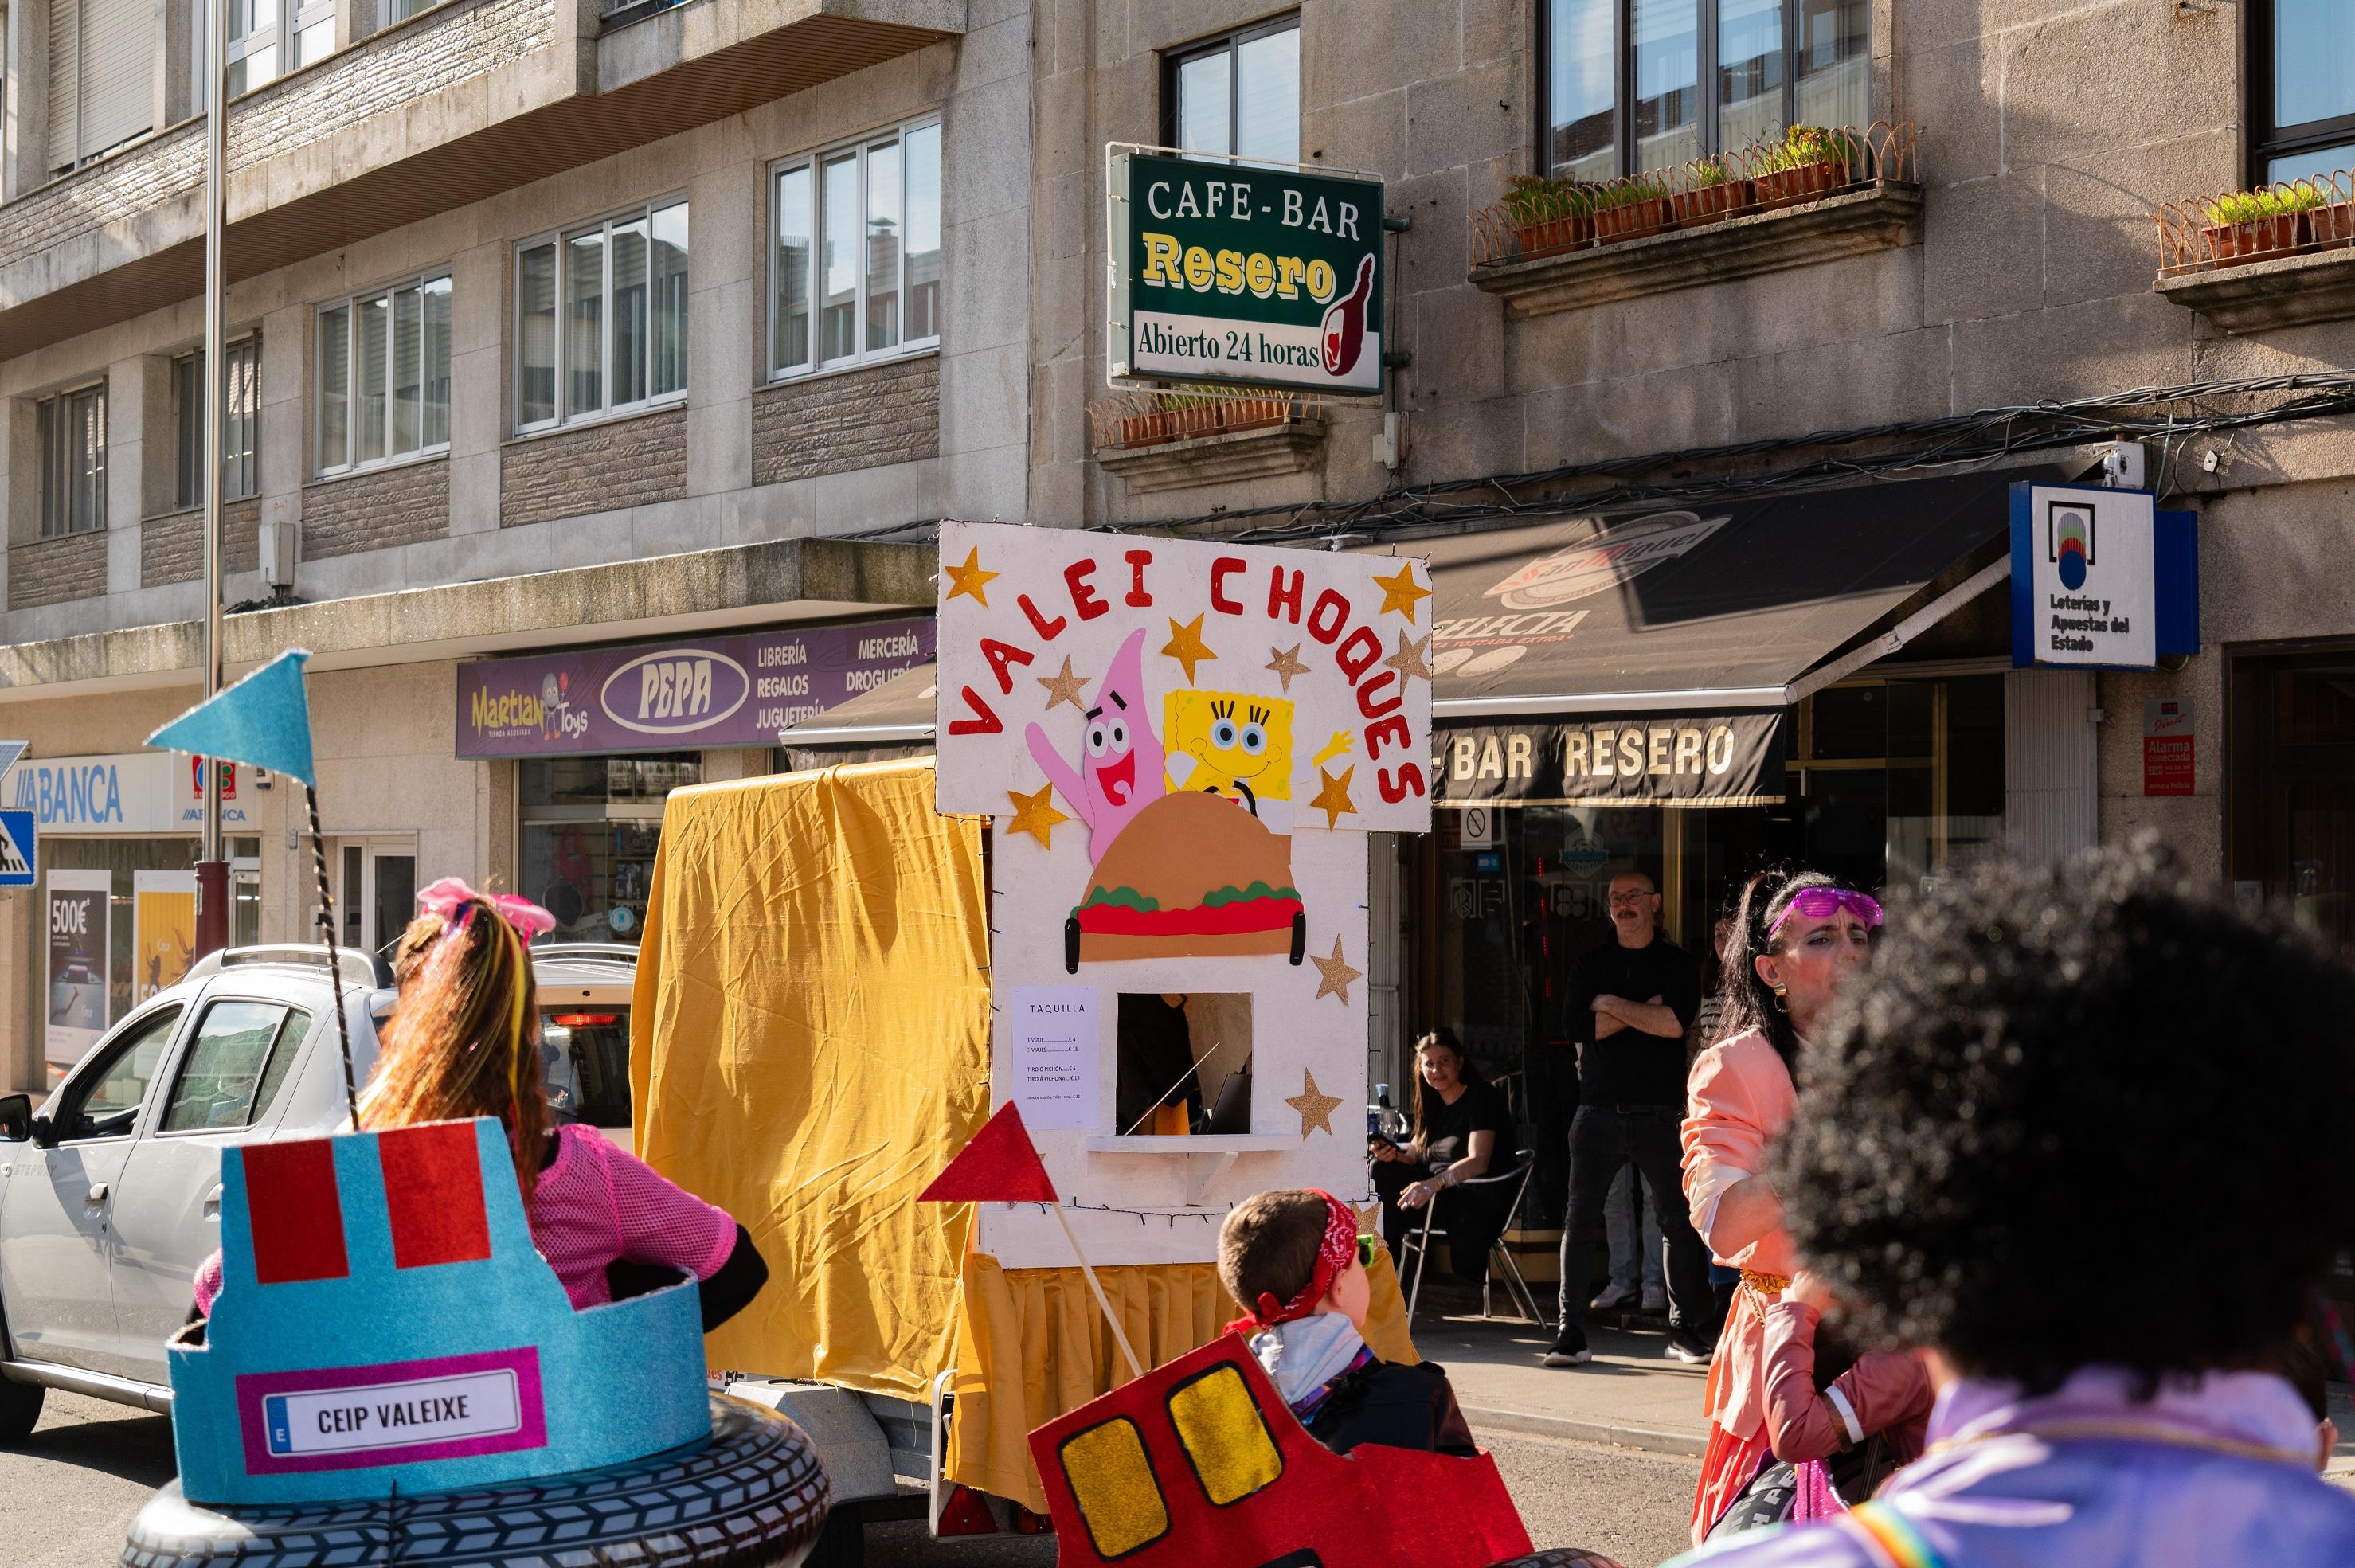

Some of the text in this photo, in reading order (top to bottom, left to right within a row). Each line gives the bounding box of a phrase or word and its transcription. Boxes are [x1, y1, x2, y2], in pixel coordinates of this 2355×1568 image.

[1142, 232, 1336, 304] Resero
[1138, 322, 1320, 368] Abierto 24 horas
[2050, 593, 2111, 616] Loterías y
[2051, 614, 2129, 634] Apuestas del
[758, 638, 807, 667] LIBRERÍA
[858, 628, 919, 660] MERCERÍA
[2051, 635, 2094, 651] Estado
[638, 659, 713, 720] PEPA
[757, 675, 809, 698] REGALOS
[1211, 557, 1426, 804] CHOQUES
[557, 702, 588, 739] Toys
[1565, 725, 1735, 777] RESERO
[2148, 753, 2191, 762] conectada
[2149, 741, 2190, 753] Alarma
[1030, 1004, 1085, 1013] TAQUILLA
[318, 1394, 471, 1433] CEIP VALEIXE
[276, 1429, 286, 1442] E
